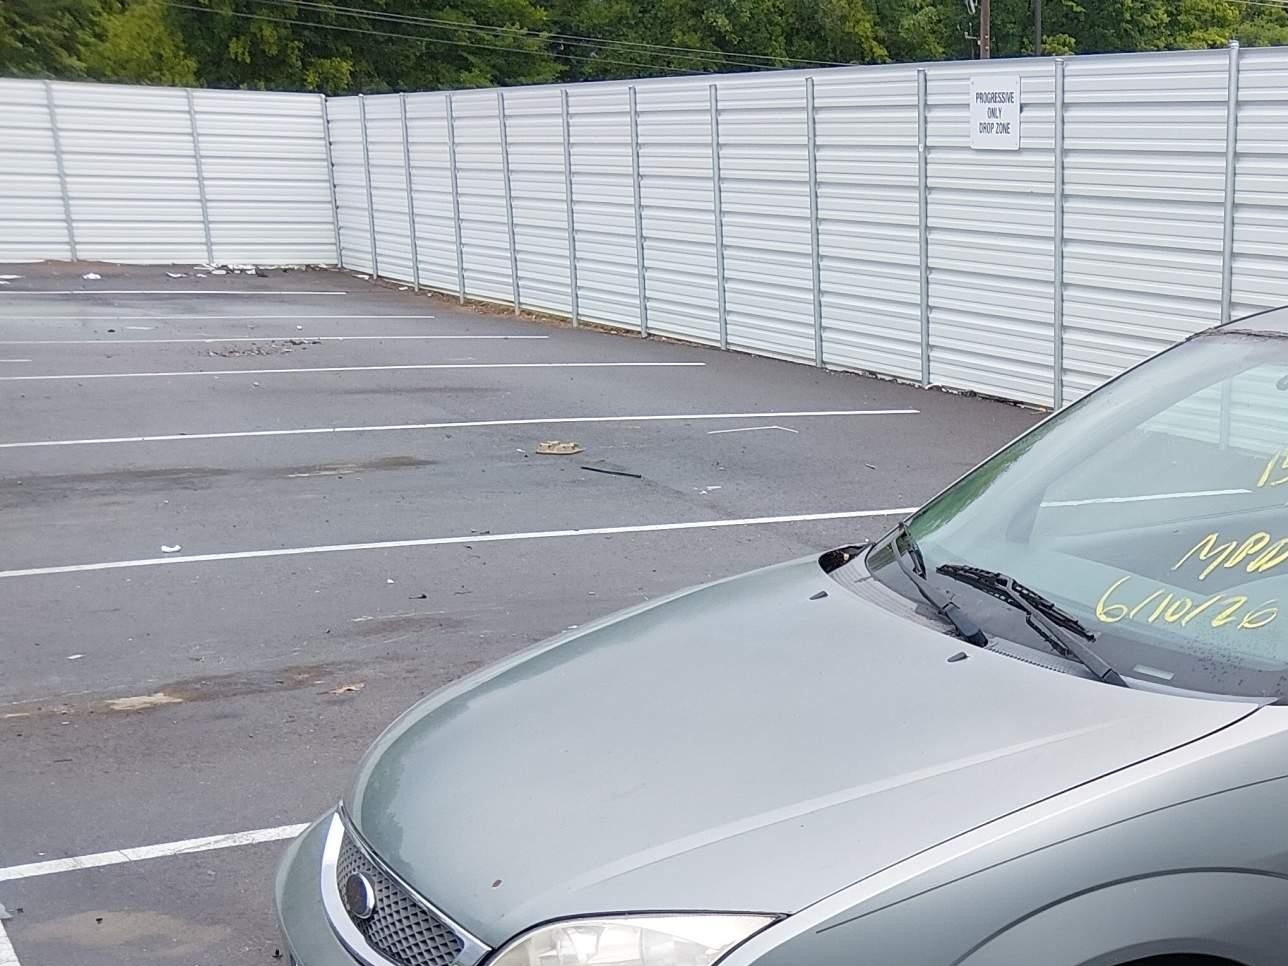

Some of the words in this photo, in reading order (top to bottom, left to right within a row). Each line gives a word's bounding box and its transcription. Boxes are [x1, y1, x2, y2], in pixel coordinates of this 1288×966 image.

[975, 91, 1015, 104] PROGRESSIVE
[987, 107, 1003, 119] ONLY
[978, 122, 994, 134] DROP
[995, 122, 1011, 134] ZONE
